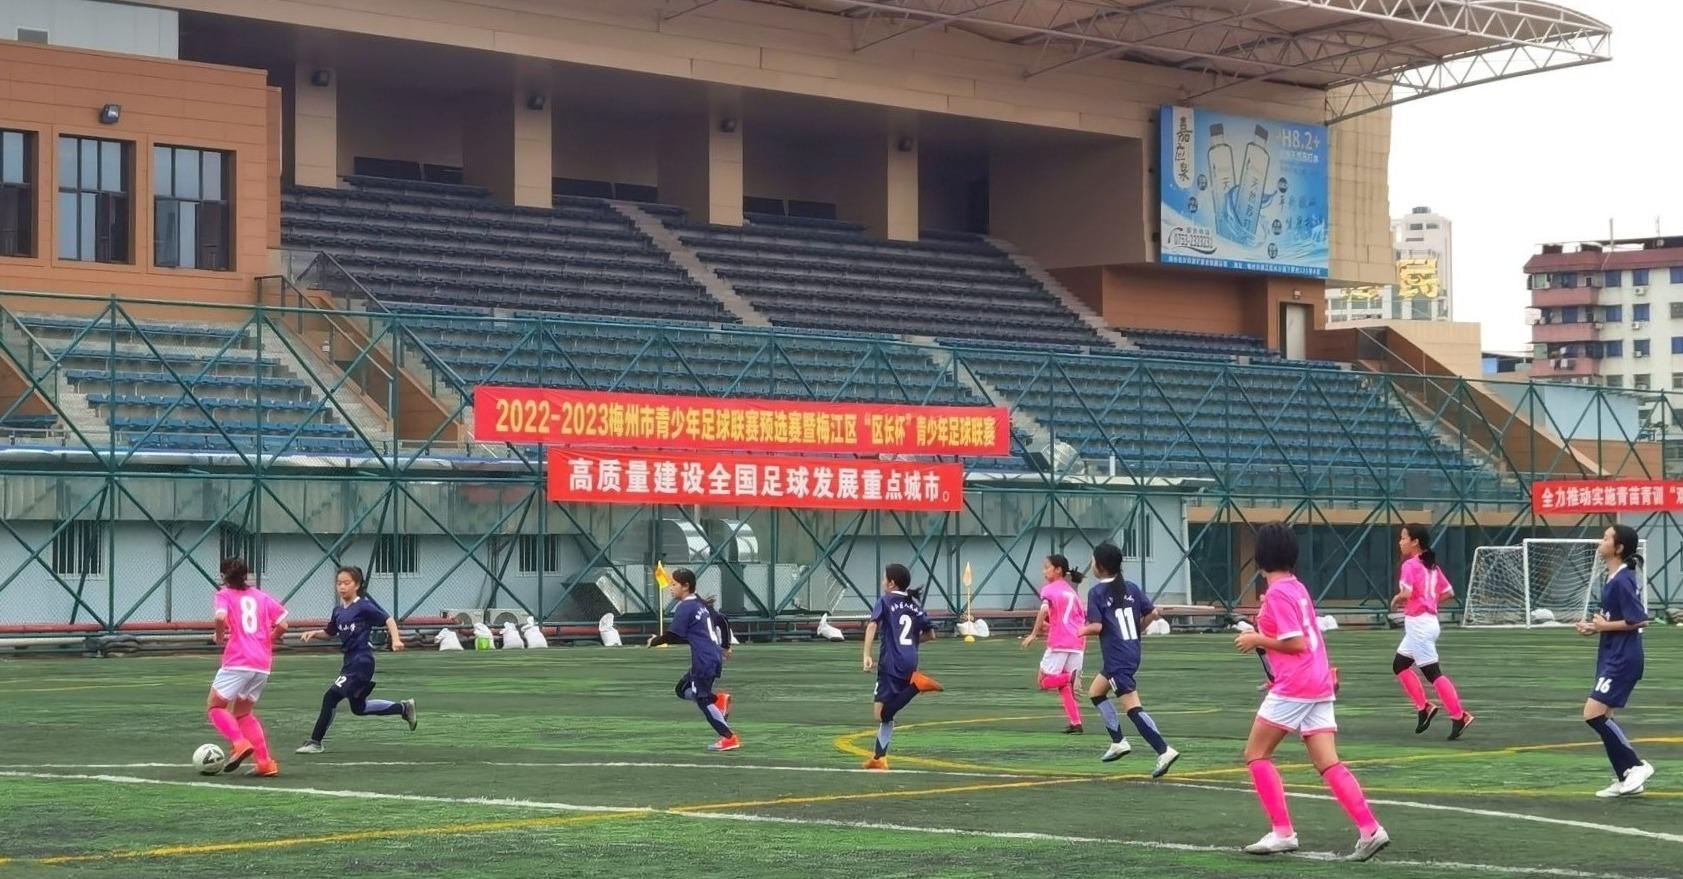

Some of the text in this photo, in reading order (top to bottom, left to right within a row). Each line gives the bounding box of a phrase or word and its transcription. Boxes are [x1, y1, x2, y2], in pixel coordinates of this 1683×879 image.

[567, 457, 950, 503] 高质量建设全国足球发展重点城市。
[239, 595, 258, 635] 8
[1062, 591, 1075, 625] 7
[1114, 606, 1138, 641] 11
[898, 614, 913, 646] 2
[1594, 676, 1613, 694] 16
